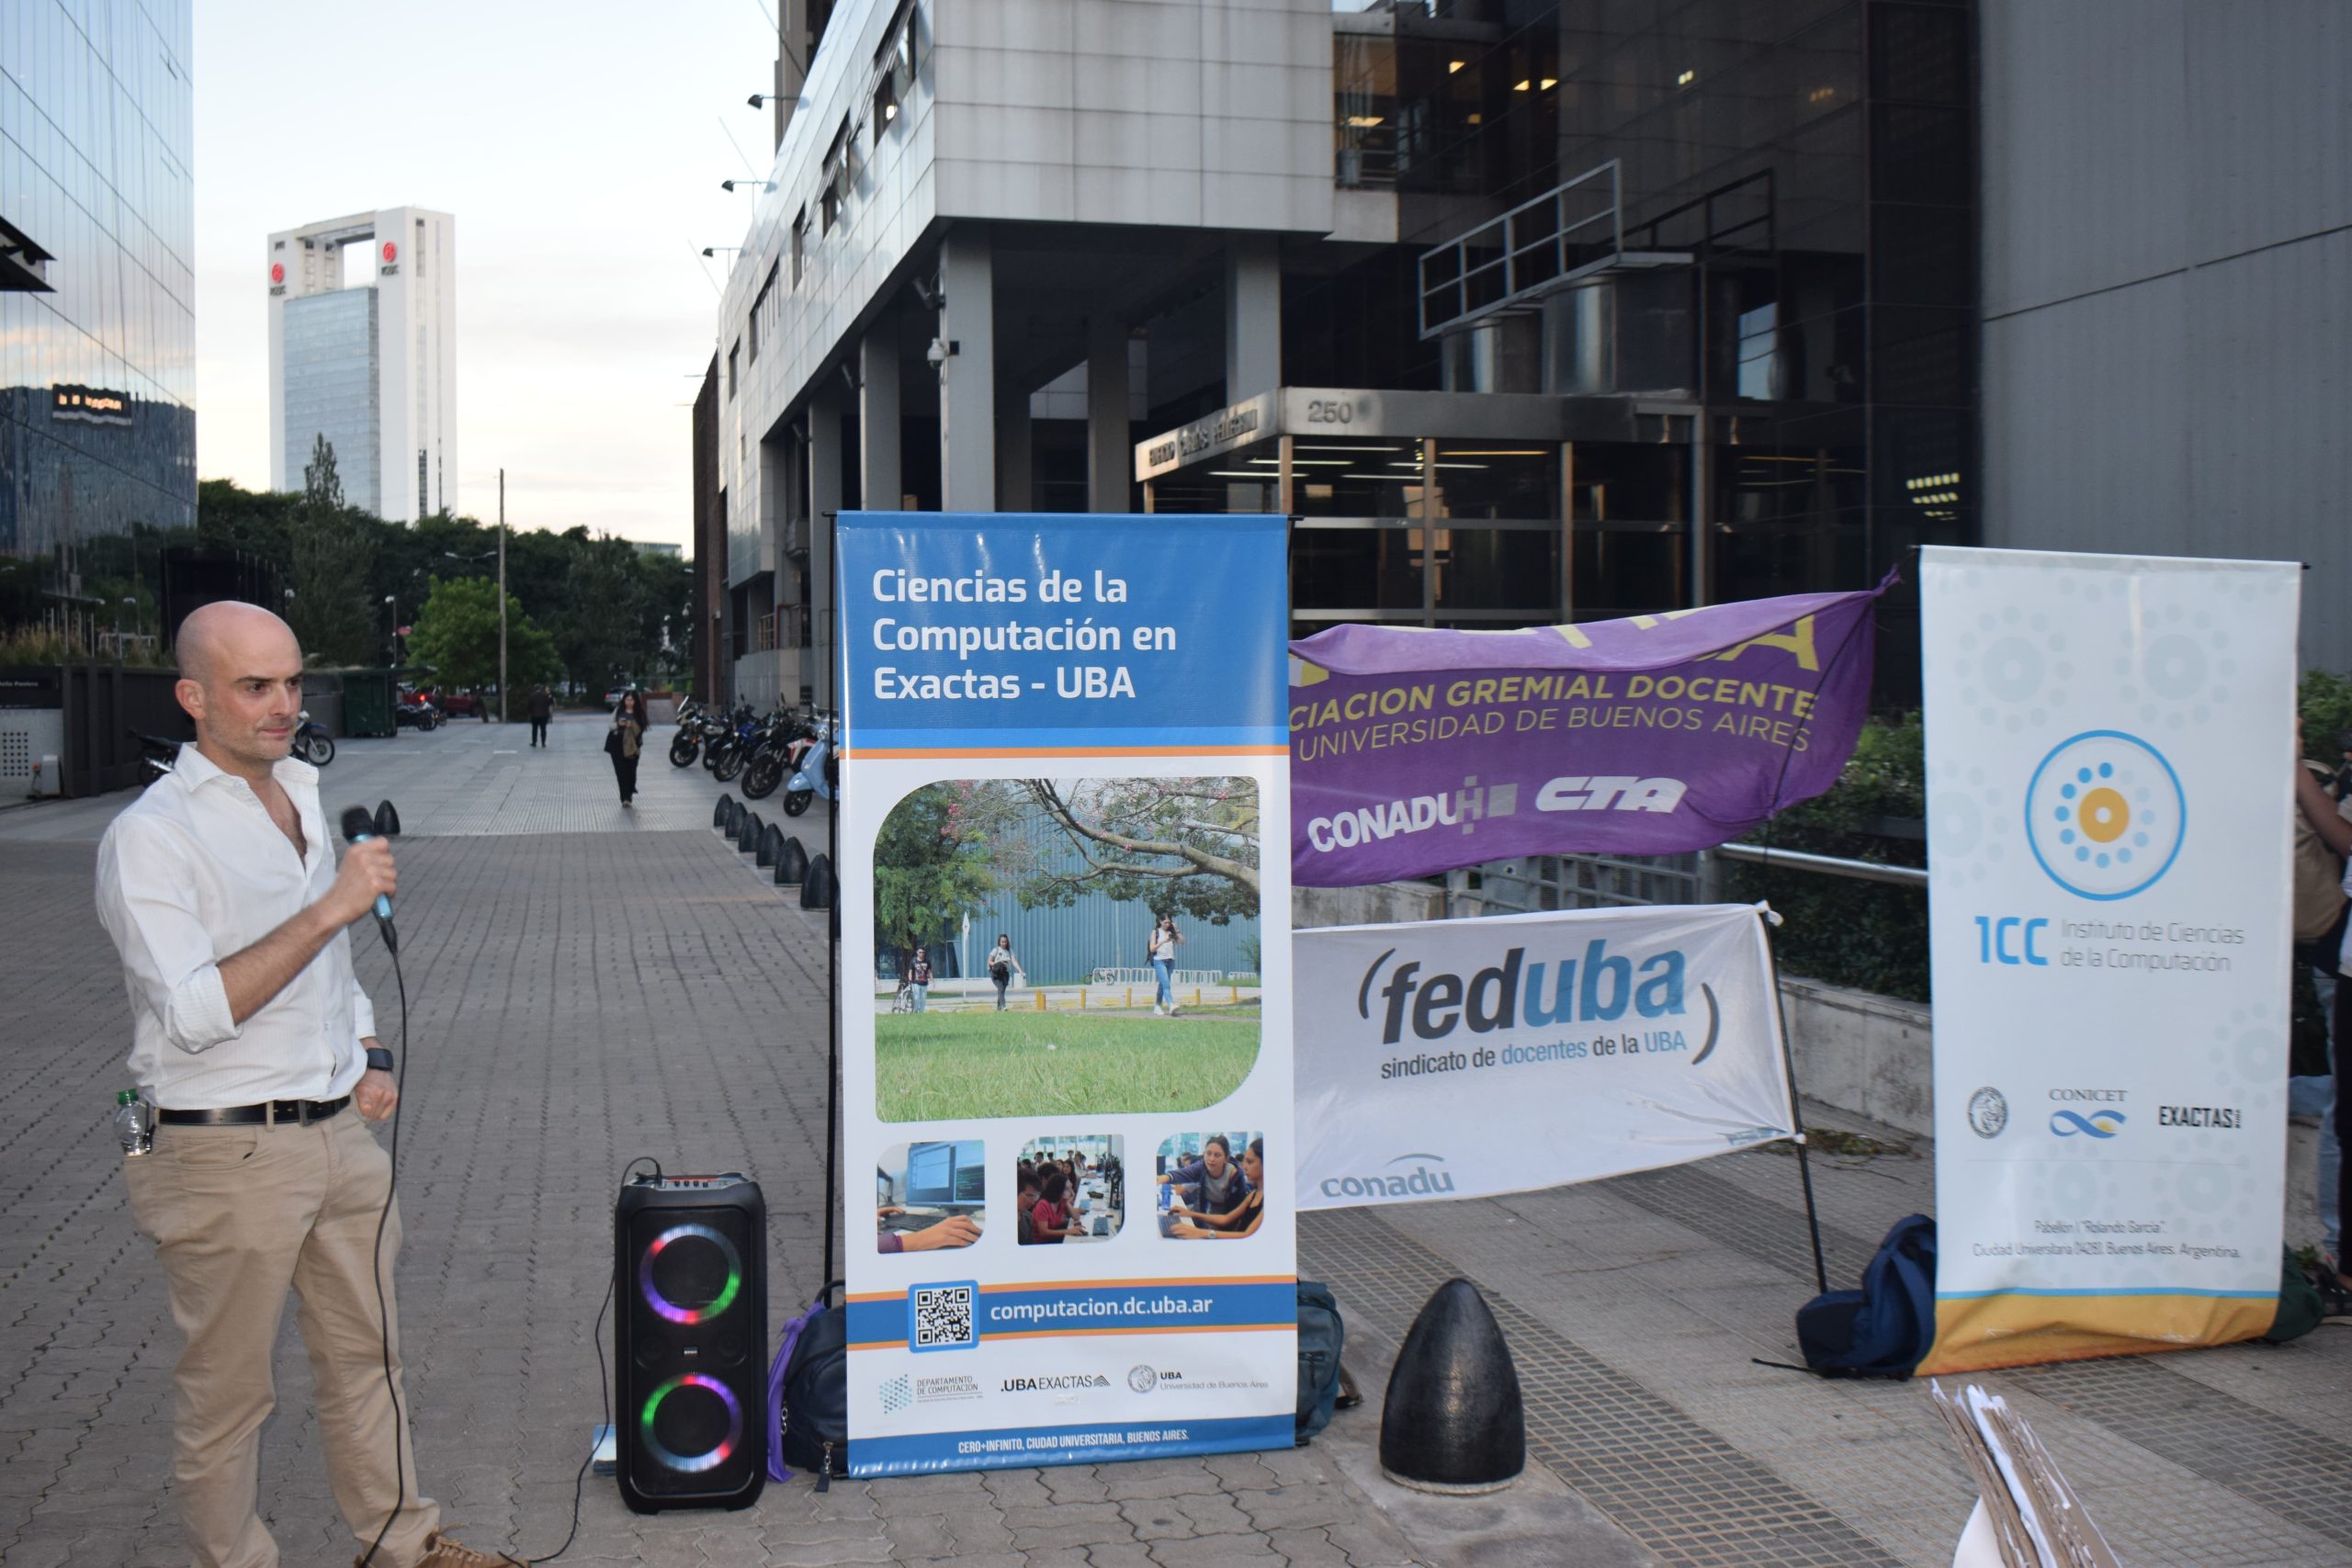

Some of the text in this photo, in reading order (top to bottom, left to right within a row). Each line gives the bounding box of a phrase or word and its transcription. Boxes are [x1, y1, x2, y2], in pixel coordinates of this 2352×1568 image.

[1308, 400, 1352, 424] 250
[872, 569, 1127, 603] Ciencias de la
[872, 618, 1176, 660] Computación en
[874, 667, 1020, 699] Exactas
[1057, 666, 1136, 698] UBA
[1446, 675, 1614, 707] GREMIAL
[1626, 675, 1819, 720] DOCENTE
[1299, 706, 1812, 761] UNIVERSIDAD DE BUENOS AIRES
[1535, 774, 1688, 814] CTA
[2061, 919, 2135, 941] Instituto
[2138, 921, 2164, 942] de
[2167, 922, 2245, 944] Ciencias
[2060, 946, 2233, 974] de la Computación
[1381, 1030, 1688, 1079] sindicato de docentes de la UBA
[2049, 1089, 2128, 1102] CONICET
[2159, 1105, 2233, 1129] EXACTAS
[1320, 1167, 1454, 1198] conadu
[2106, 1241, 2144, 1256] Buenos
[990, 1296, 1213, 1323] computacion.dc.uba.ar
[917, 1376, 973, 1387] DEPARTAMENTO
[1160, 1371, 1182, 1380] UBA
[1160, 1382, 1204, 1390] Universidad
[1206, 1381, 1217, 1389] de
[1219, 1380, 1248, 1388] Buenos
[917, 1386, 925, 1395] DE
[958, 1429, 1190, 1454] CERO+INFINITO, CIUDAD UNIVERSITARIA, BUENOS AIRES.
